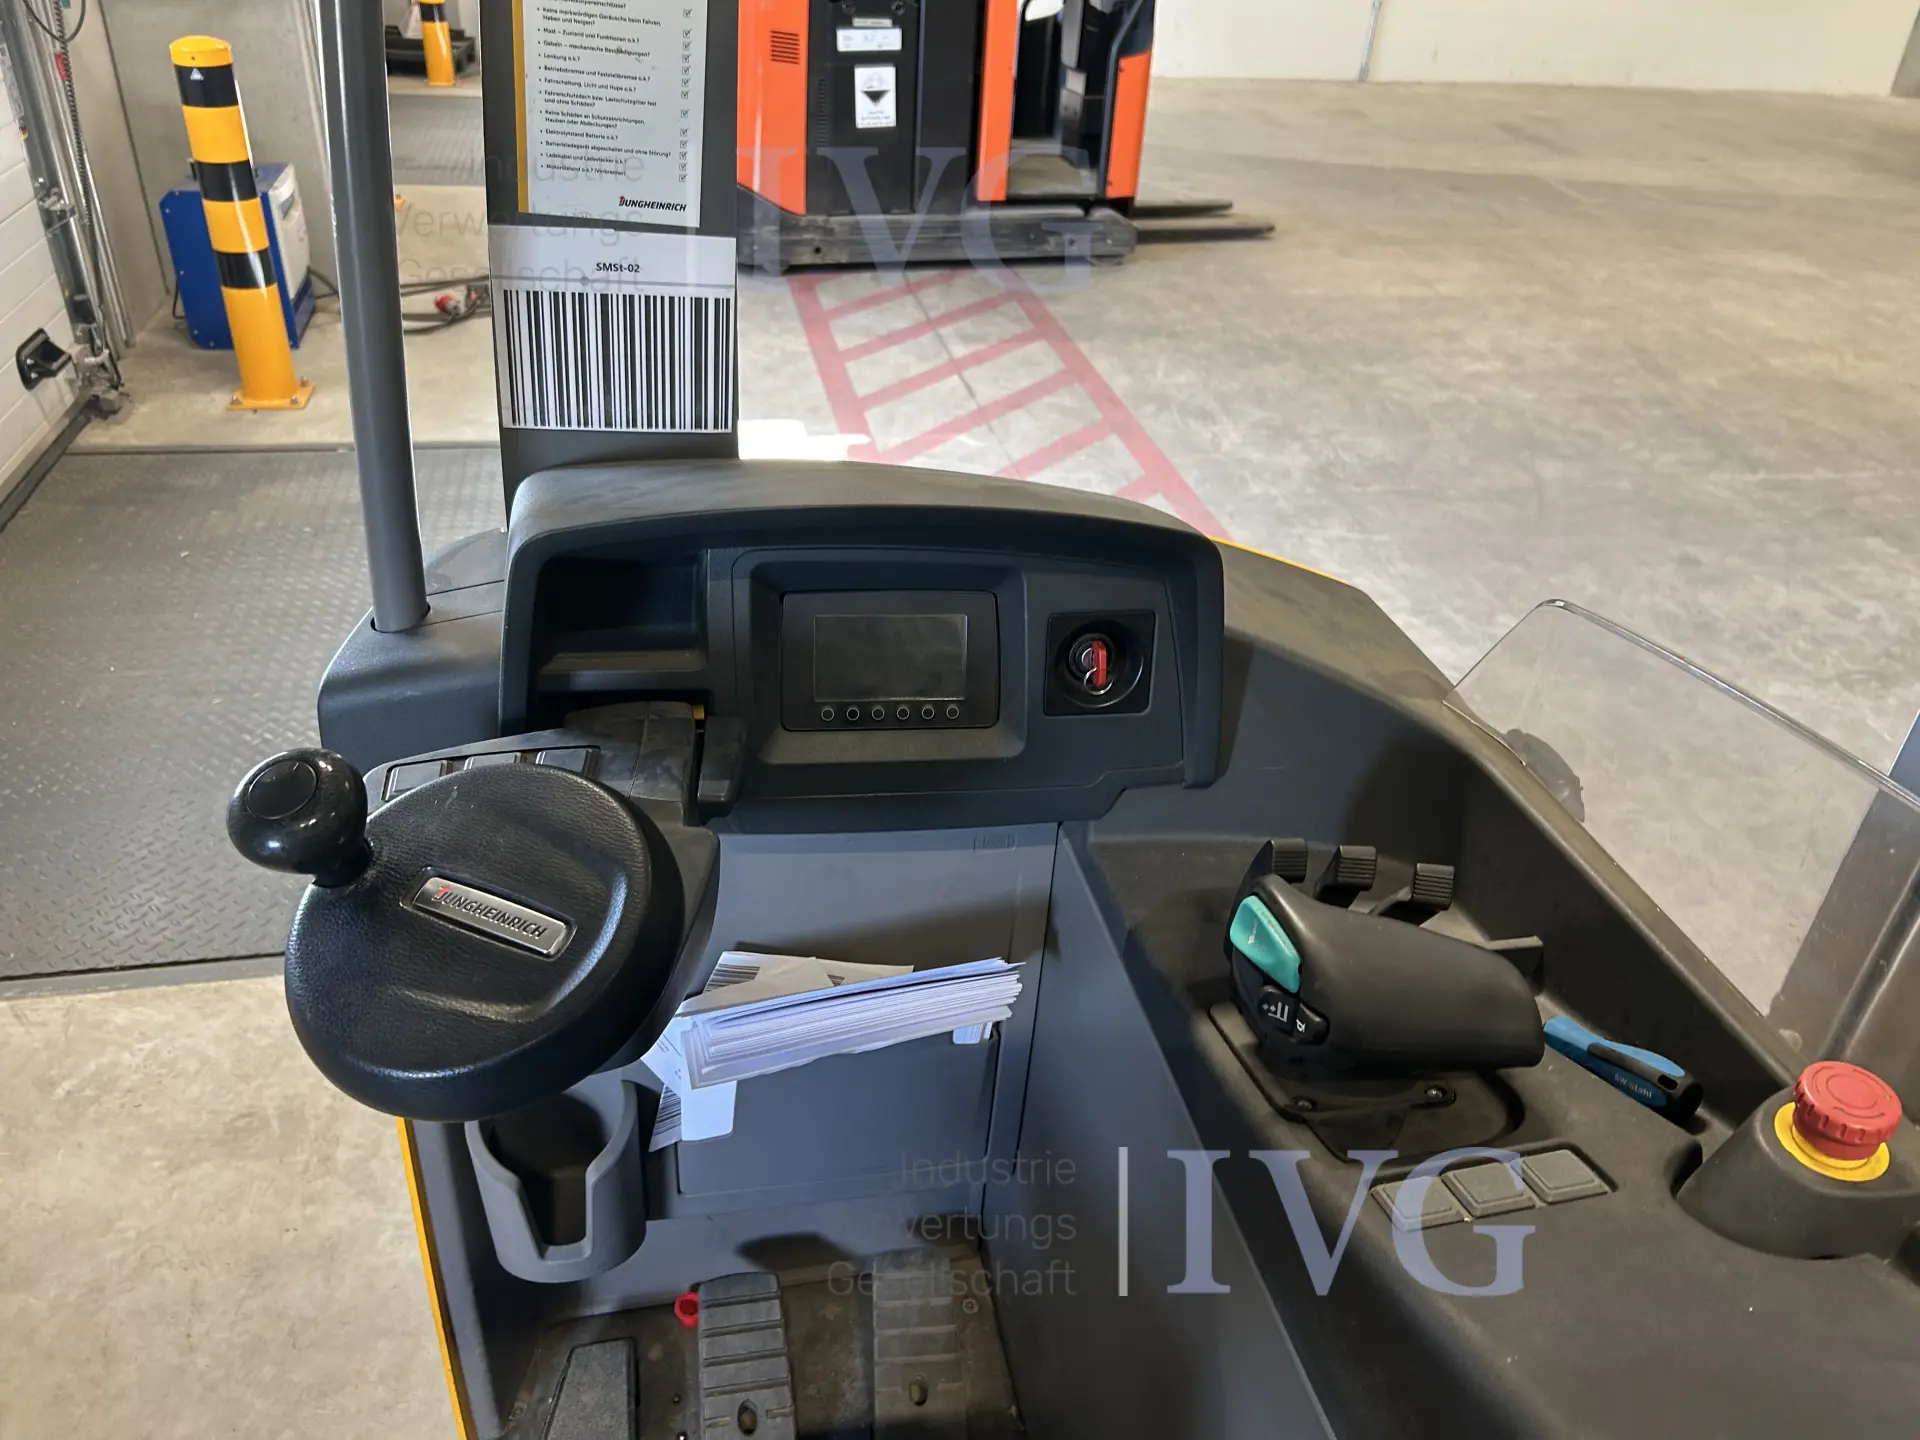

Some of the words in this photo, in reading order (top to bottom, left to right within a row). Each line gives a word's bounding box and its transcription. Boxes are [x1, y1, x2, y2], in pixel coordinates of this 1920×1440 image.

[618, 195, 687, 212] JUNGHEINRICH
[596, 262, 640, 273] SMSt-02
[431, 884, 548, 939] JUNGHEINRICH
